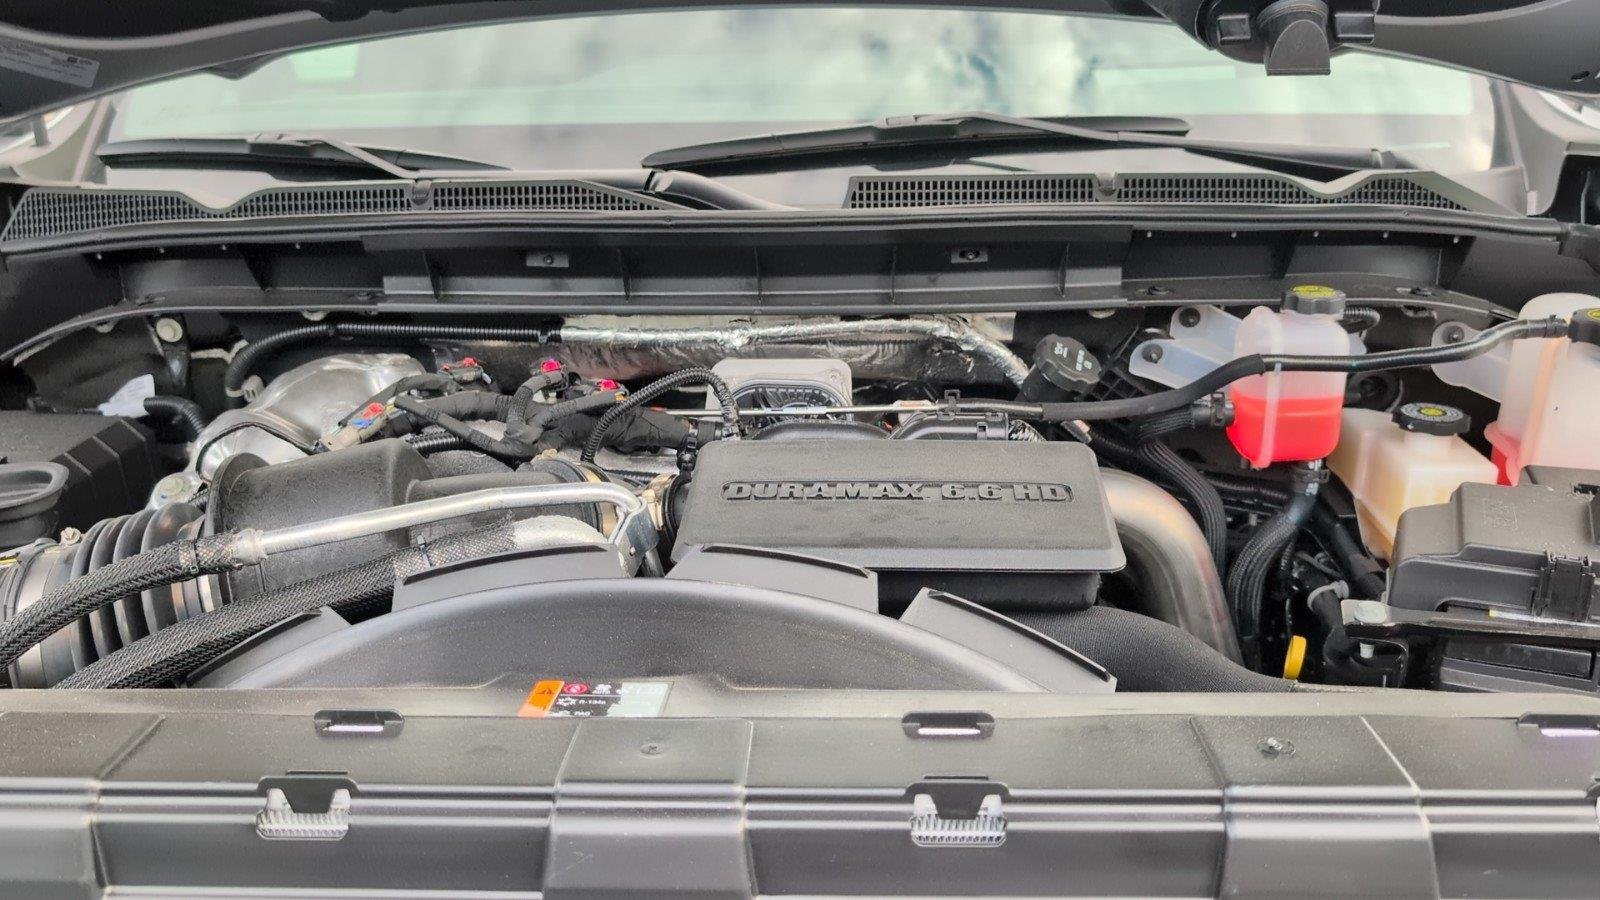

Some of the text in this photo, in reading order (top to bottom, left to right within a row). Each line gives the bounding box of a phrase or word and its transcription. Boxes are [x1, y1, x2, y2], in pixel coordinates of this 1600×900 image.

[726, 482, 1070, 501] DURAMAX 6.6 HD
